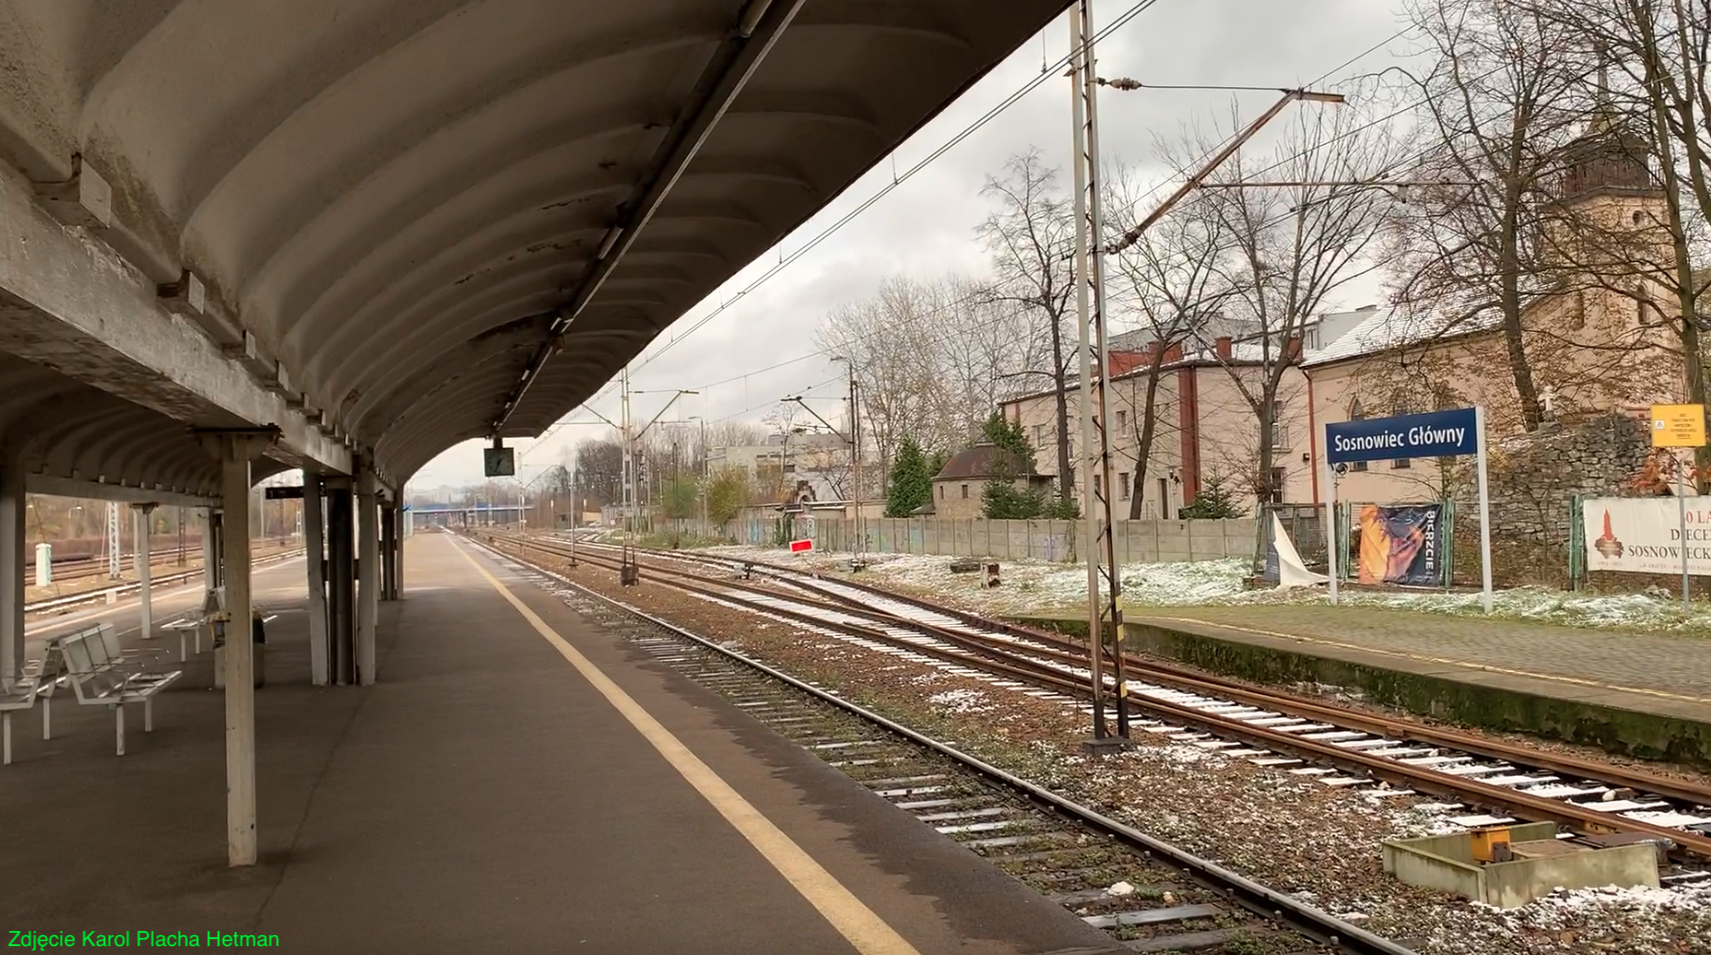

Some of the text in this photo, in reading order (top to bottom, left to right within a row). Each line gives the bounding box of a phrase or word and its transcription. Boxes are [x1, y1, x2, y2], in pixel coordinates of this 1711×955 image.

[1334, 425, 1465, 452] Sosnowiec Główny
[1628, 545, 1711, 559] SOSNOWECK
